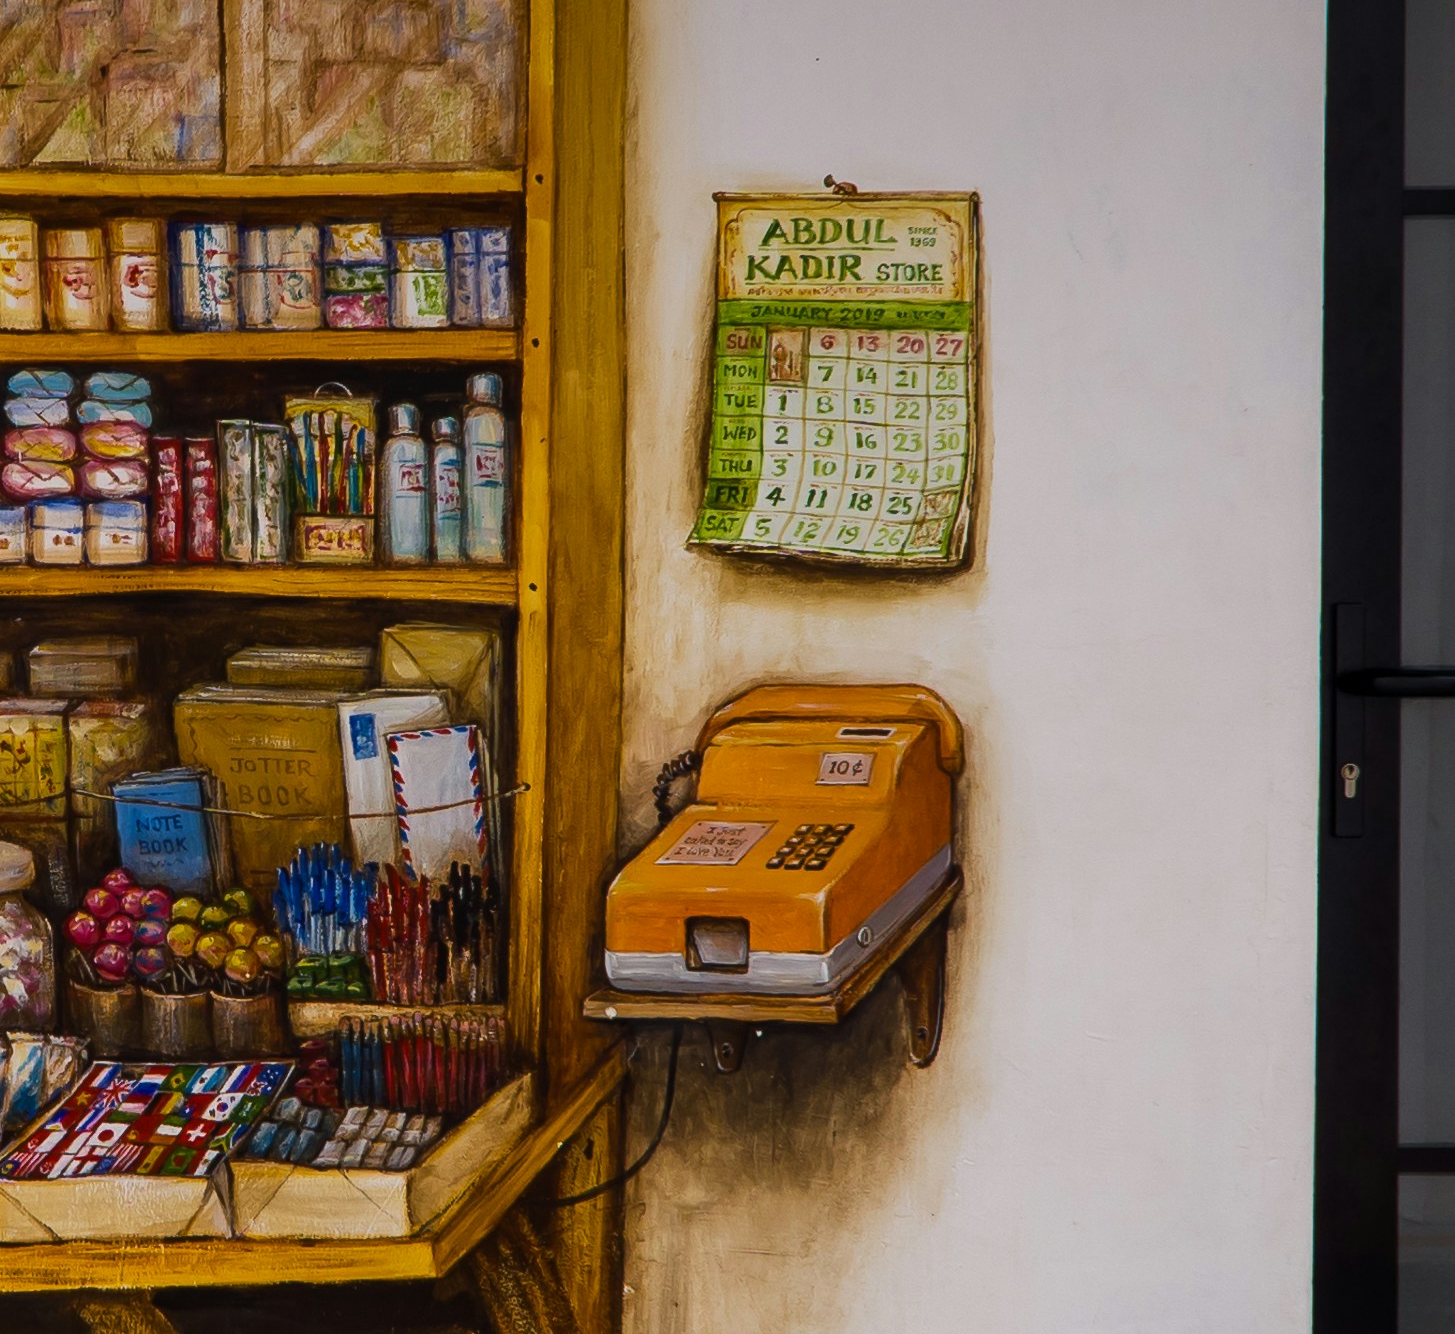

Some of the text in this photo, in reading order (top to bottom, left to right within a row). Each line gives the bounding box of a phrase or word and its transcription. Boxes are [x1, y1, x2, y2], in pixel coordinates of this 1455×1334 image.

[759, 218, 898, 247] ABDUL
[745, 255, 943, 282] KADIR STORE
[751, 305, 833, 320] JANUARY
[840, 308, 886, 321] 2019
[726, 333, 963, 357] SUN 6 13 20 27
[723, 364, 959, 390] MON 7 14 21 28
[723, 393, 958, 421] TUE 1 8 15 22 29
[722, 425, 960, 452] WED 2 9 16 23 30
[719, 458, 954, 484] THU 3 10 17 24 31
[714, 486, 914, 515] FRI 4 11 18 25
[704, 517, 904, 547] SAT 5 12 19 26
[230, 758, 316, 777] JOTTER
[238, 785, 312, 806] BOOK
[136, 814, 183, 832] NOTE
[138, 837, 188, 854] BOOK
